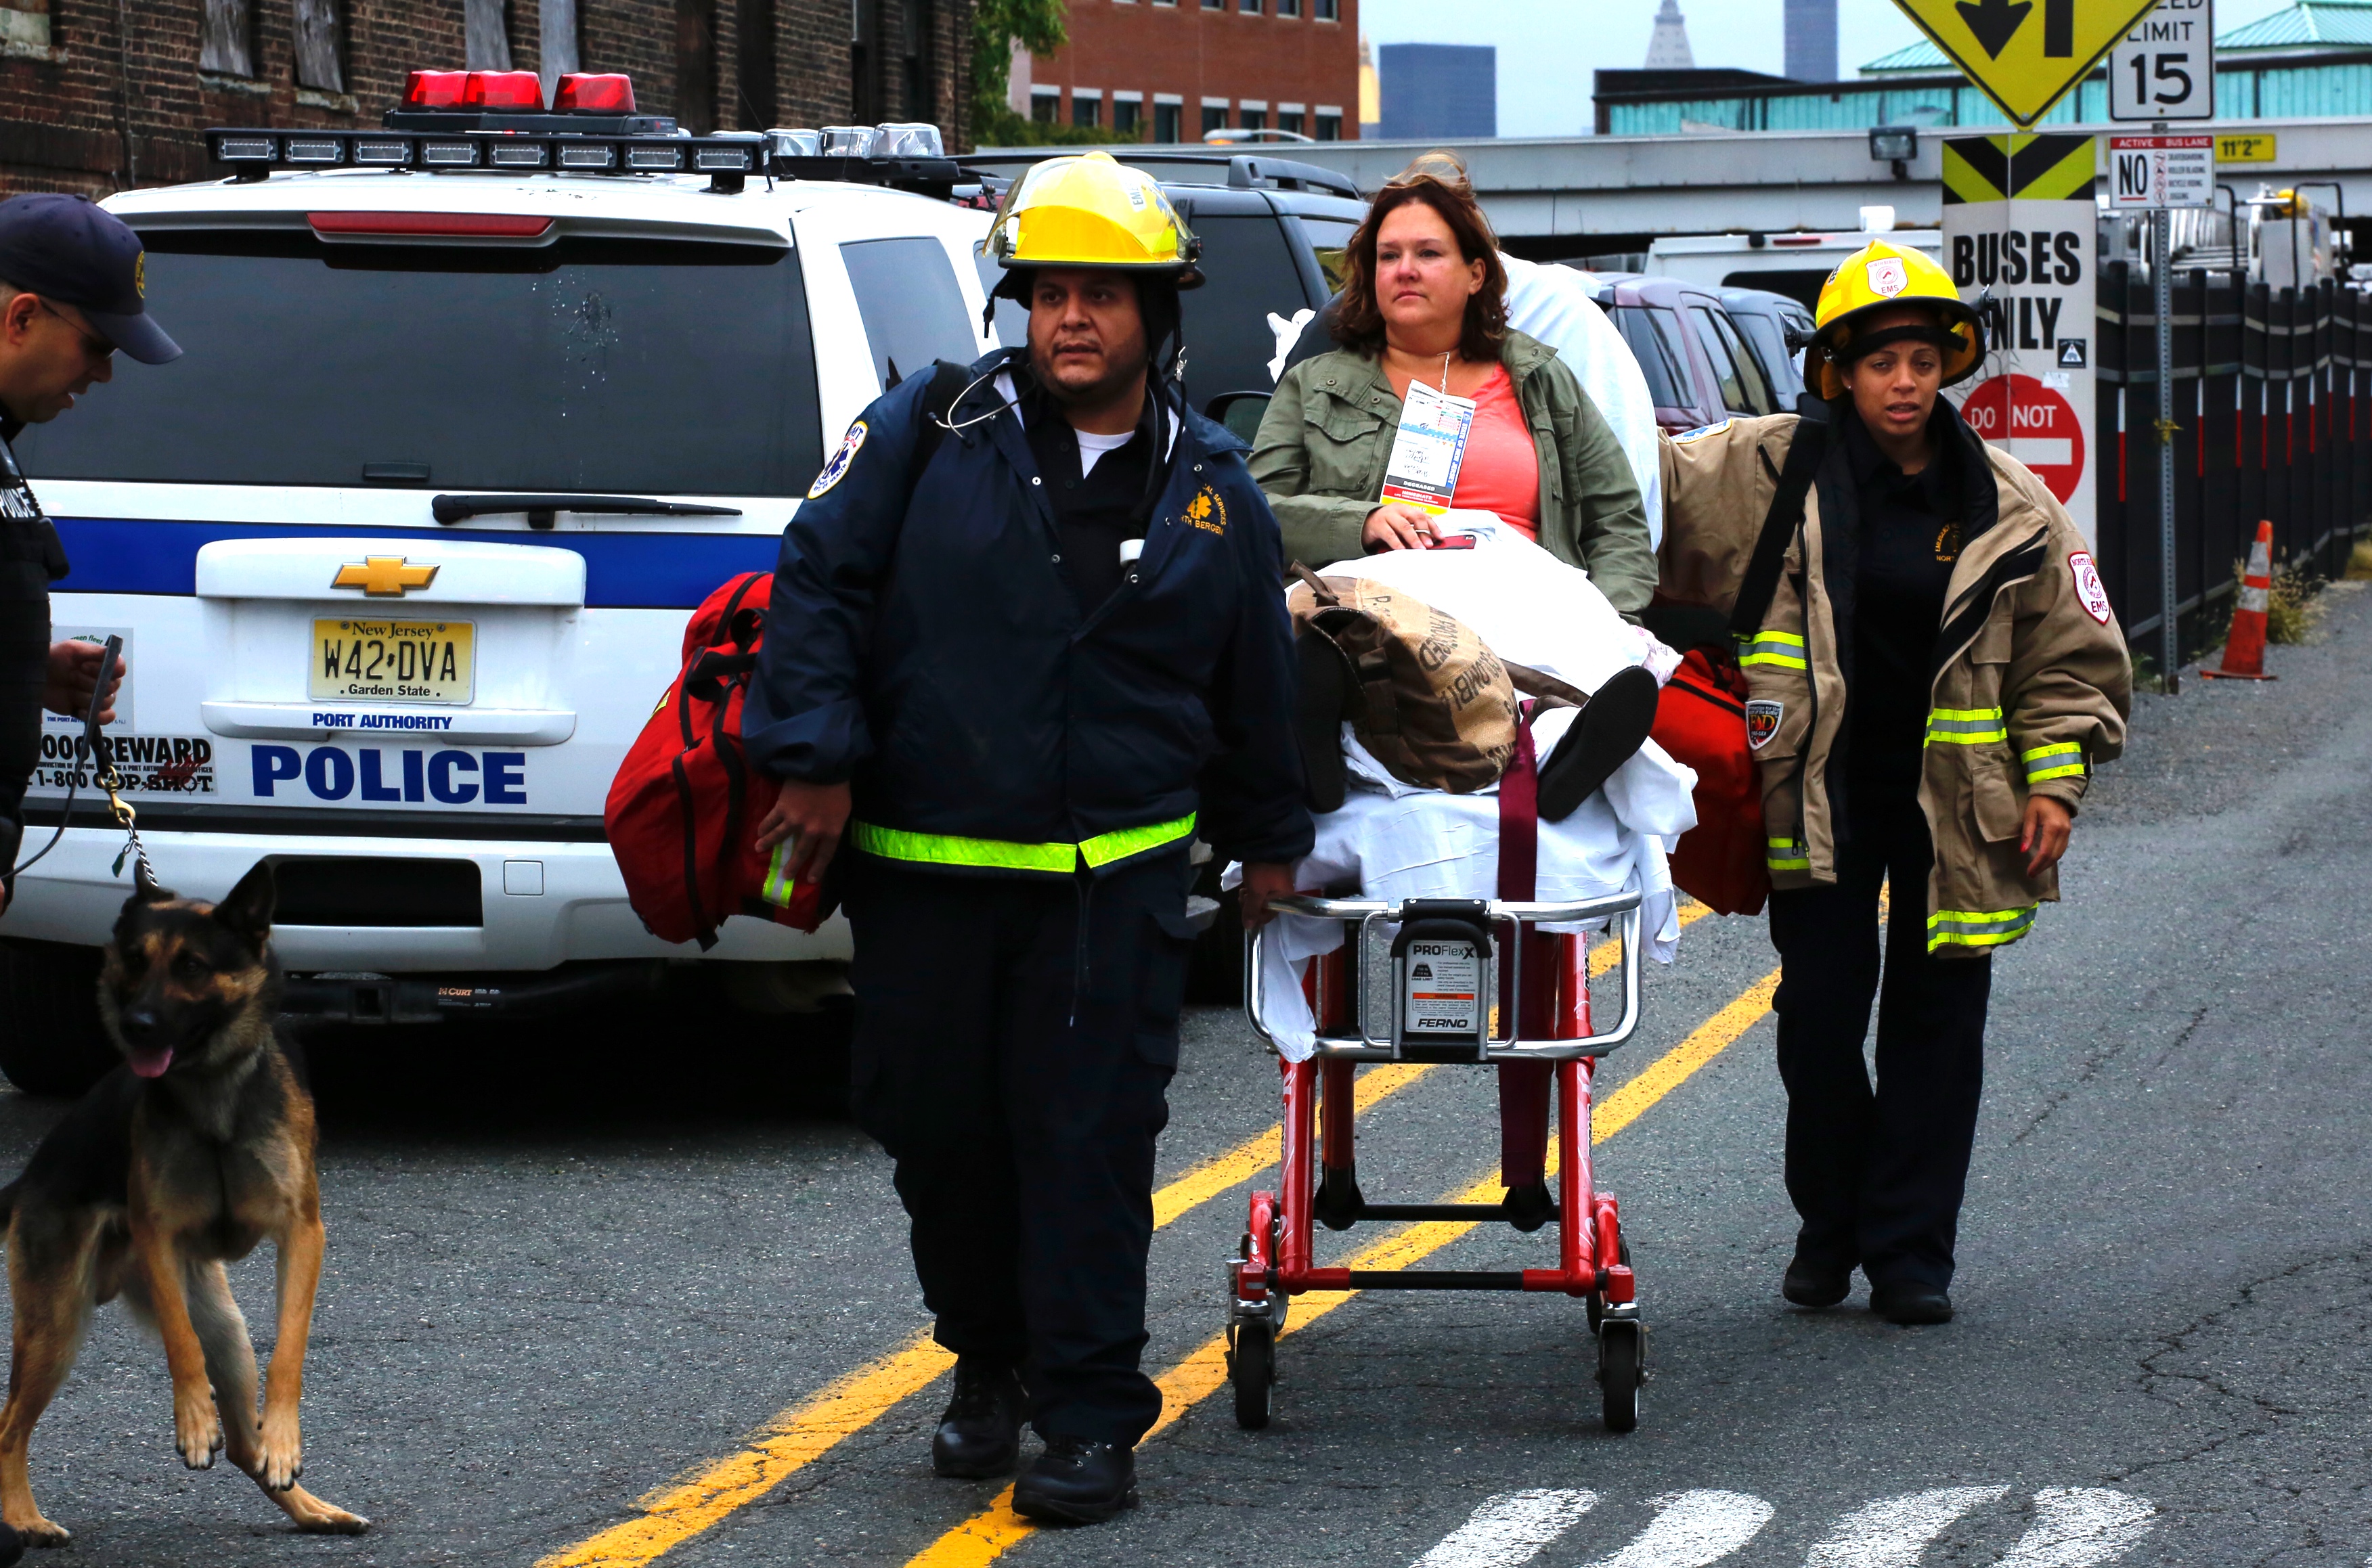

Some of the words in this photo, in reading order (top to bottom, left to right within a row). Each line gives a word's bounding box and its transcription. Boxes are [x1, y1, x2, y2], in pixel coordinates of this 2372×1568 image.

[2130, 53, 2192, 105] 15
[2120, 138, 2154, 147] ACTIVE
[2166, 137, 2182, 146] BUS
[2185, 137, 2209, 146] LANE
[2120, 154, 2147, 195] NO
[1953, 231, 2081, 287] BUSES
[1881, 284, 1899, 294] EMS
[1989, 297, 2063, 351] NLY
[1971, 407, 1996, 430] DO
[2013, 405, 2057, 428] NOT
[1403, 480, 1436, 491] DECEASED
[1401, 489, 1433, 501] IMMEDIATE
[1213, 493, 1227, 526] SERVICES
[1195, 520, 1224, 536] BERGEN
[2090, 600, 2108, 613] EMS
[352, 623, 387, 635] New
[389, 623, 435, 640] Jersey
[324, 639, 385, 679] W42
[398, 641, 456, 681] DVA
[349, 684, 393, 695] Garden
[398, 686, 431, 696] State
[313, 713, 355, 727] PORT
[359, 714, 453, 730] AUTHORITY
[37, 770, 89, 789] 1-800
[251, 744, 527, 805] POLICE
[448, 988, 473, 996] CURT
[1418, 1018, 1468, 1028] FERNO
